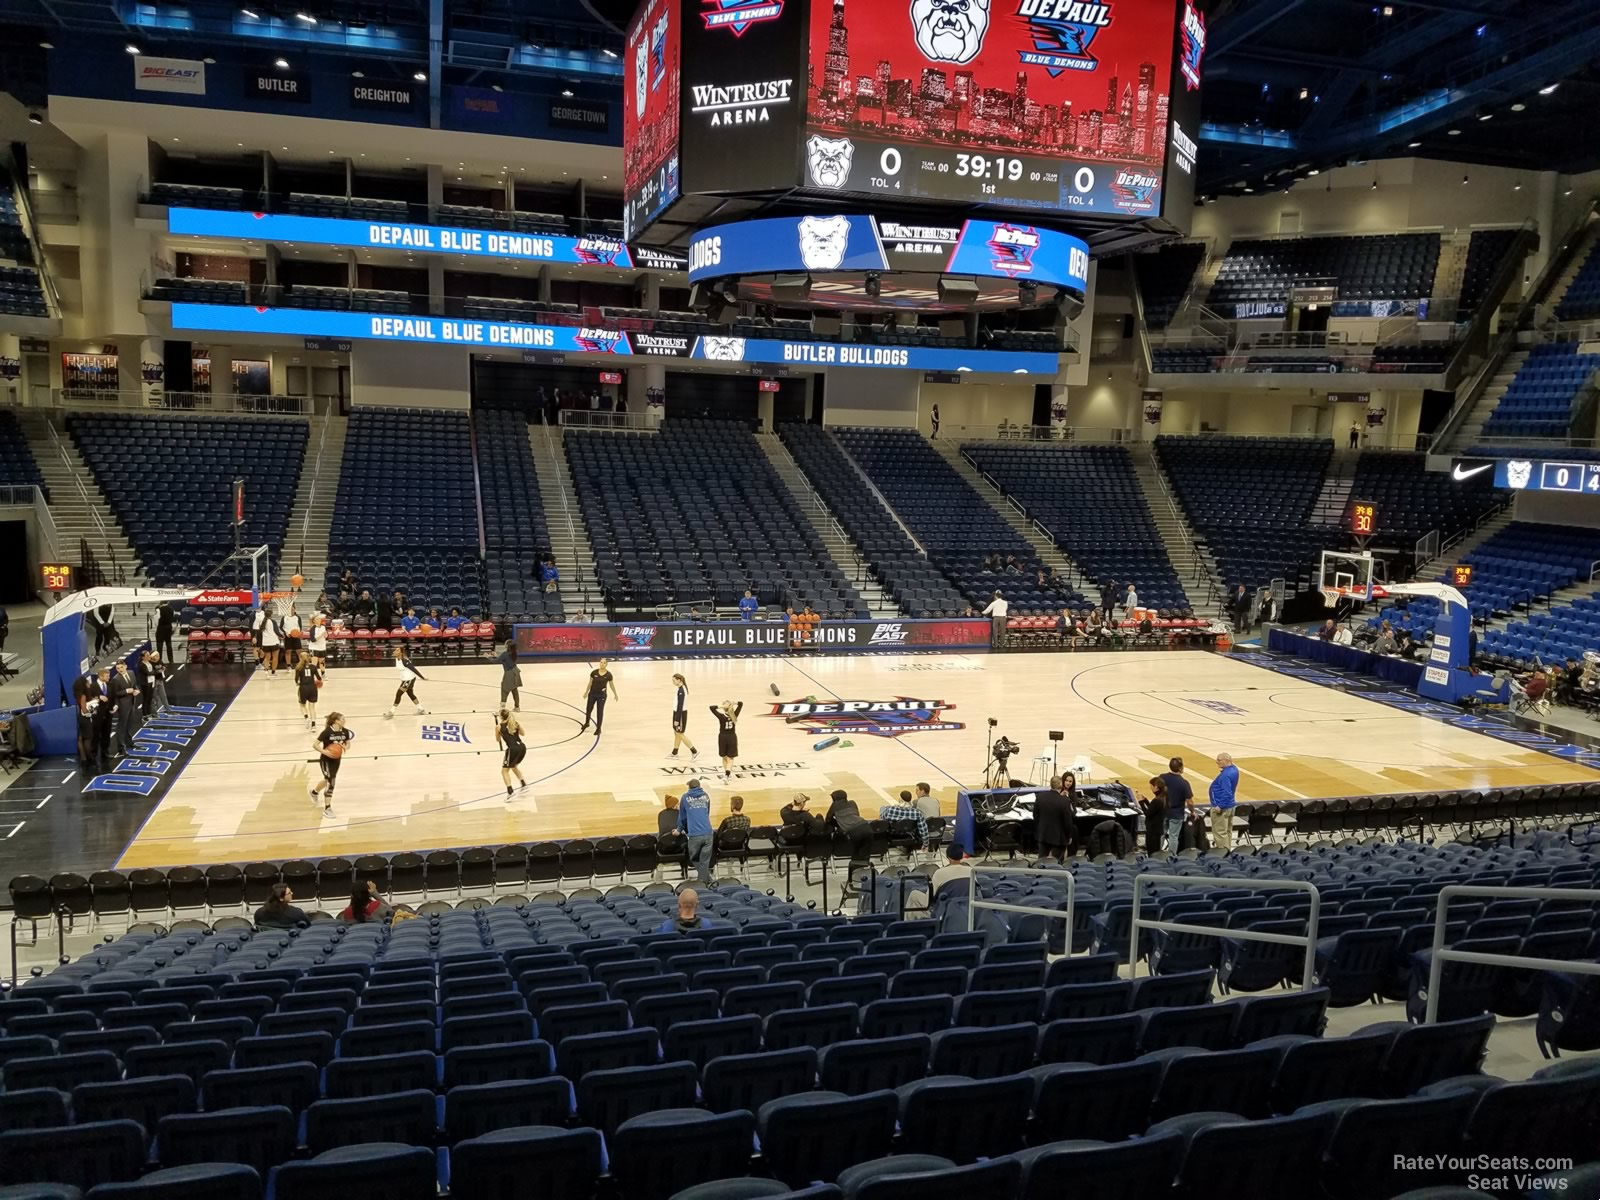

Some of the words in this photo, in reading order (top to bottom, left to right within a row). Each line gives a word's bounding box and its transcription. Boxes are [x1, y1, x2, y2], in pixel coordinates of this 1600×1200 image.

[712, 13, 736, 24] BLUE
[738, 6, 776, 20] DEMONS
[1025, 54, 1050, 64] BLUE
[1054, 56, 1094, 70] DEMONS
[258, 78, 297, 92] BUTLER
[354, 87, 410, 104] CREIGHTON
[692, 79, 792, 106] WINTRUST
[552, 106, 606, 124] GEORGETOWN
[711, 107, 770, 126] ARENA
[880, 148, 902, 176] 0
[938, 163, 949, 172] 00
[955, 154, 1023, 181] 39:19
[1176, 152, 1191, 174] ARENA
[870, 178, 888, 188] TOL
[894, 180, 900, 189] 4
[1030, 172, 1040, 182] 00
[1074, 167, 1094, 193] 0
[982, 183, 996, 194] 1st
[1068, 196, 1084, 204] TOL
[1088, 198, 1094, 206] 4
[880, 223, 960, 240] WINTRUST
[369, 225, 434, 248] DEPAUL
[440, 230, 482, 251] BLUE
[488, 234, 554, 257] DEMONS
[894, 243, 943, 254] ARENA
[648, 260, 678, 269] ARENA
[372, 317, 436, 339] DEPAUL
[442, 322, 484, 342] BLUE
[489, 324, 554, 346] DEMONS
[306, 342, 319, 350] 106
[636, 334, 688, 347] WINTRUST
[646, 348, 678, 356] ARENA
[784, 344, 835, 362] BUTLER
[840, 346, 908, 366] BULLDOGS
[552, 356, 564, 364] 109
[1557, 468, 1568, 486] 0
[1588, 474, 1600, 491] 4
[1356, 506, 1372, 516] 39:18
[1358, 516, 1370, 530] 30
[44, 566, 69, 575] 39:18
[50, 576, 64, 587] 30
[1458, 574, 1466, 583] 30
[875, 624, 902, 632] BIG
[673, 629, 737, 646] DEPAUL
[746, 628, 785, 644] BLUE
[870, 632, 908, 640] EAST
[782, 700, 948, 714] DEPAUL
[422, 725, 440, 741] BIG
[442, 721, 460, 742] EAST
[879, 724, 955, 732] DEMONS
[81, 702, 217, 796] DEPAUL
